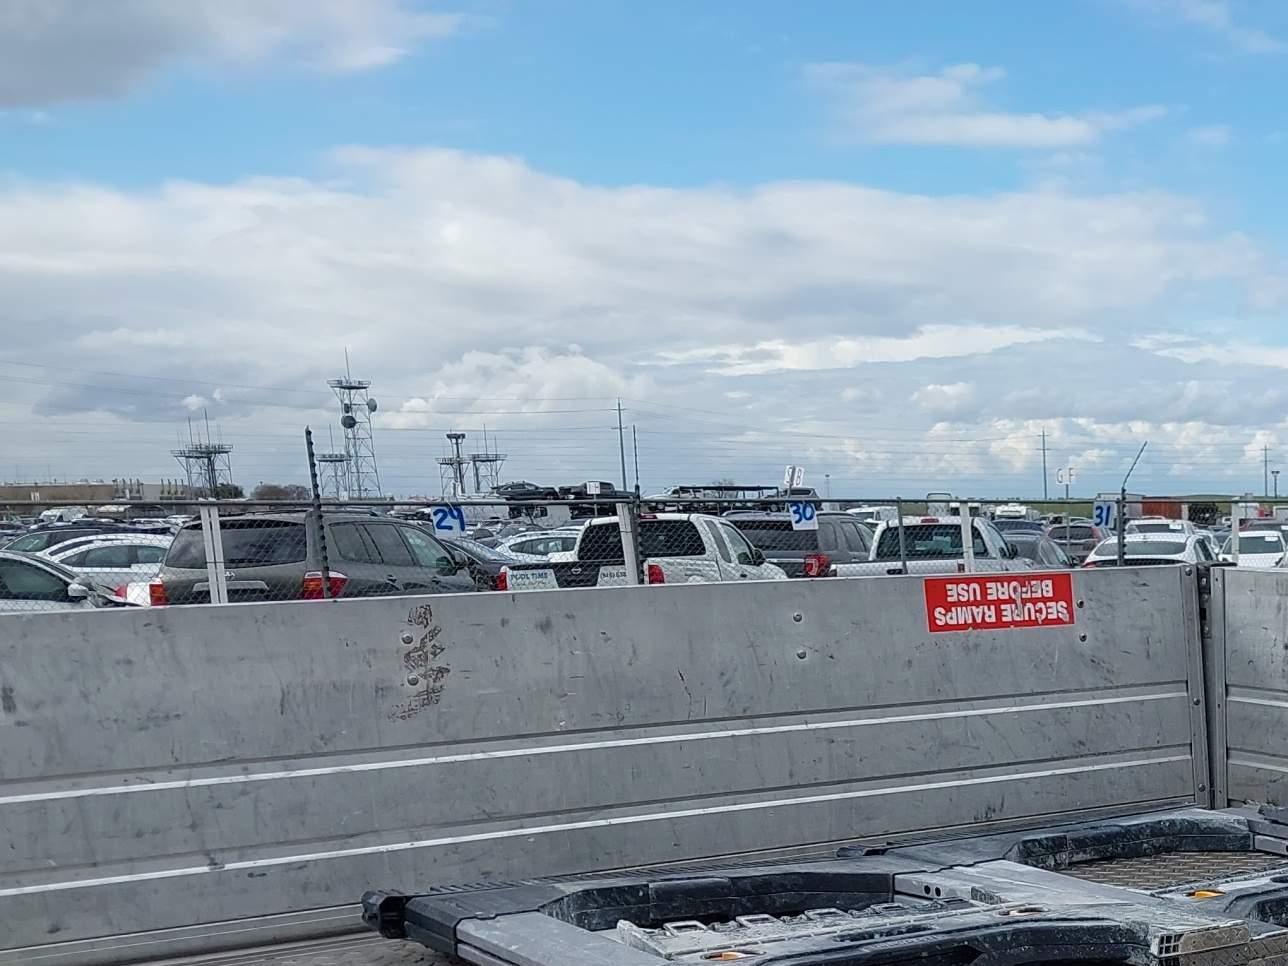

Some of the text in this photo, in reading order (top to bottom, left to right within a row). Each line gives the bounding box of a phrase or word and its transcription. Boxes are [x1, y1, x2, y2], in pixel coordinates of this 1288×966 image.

[790, 502, 815, 524] 30
[1094, 504, 1111, 527] 31
[946, 579, 1053, 602] BEFORE USE
[934, 601, 1069, 626] SECURE RAMPS
